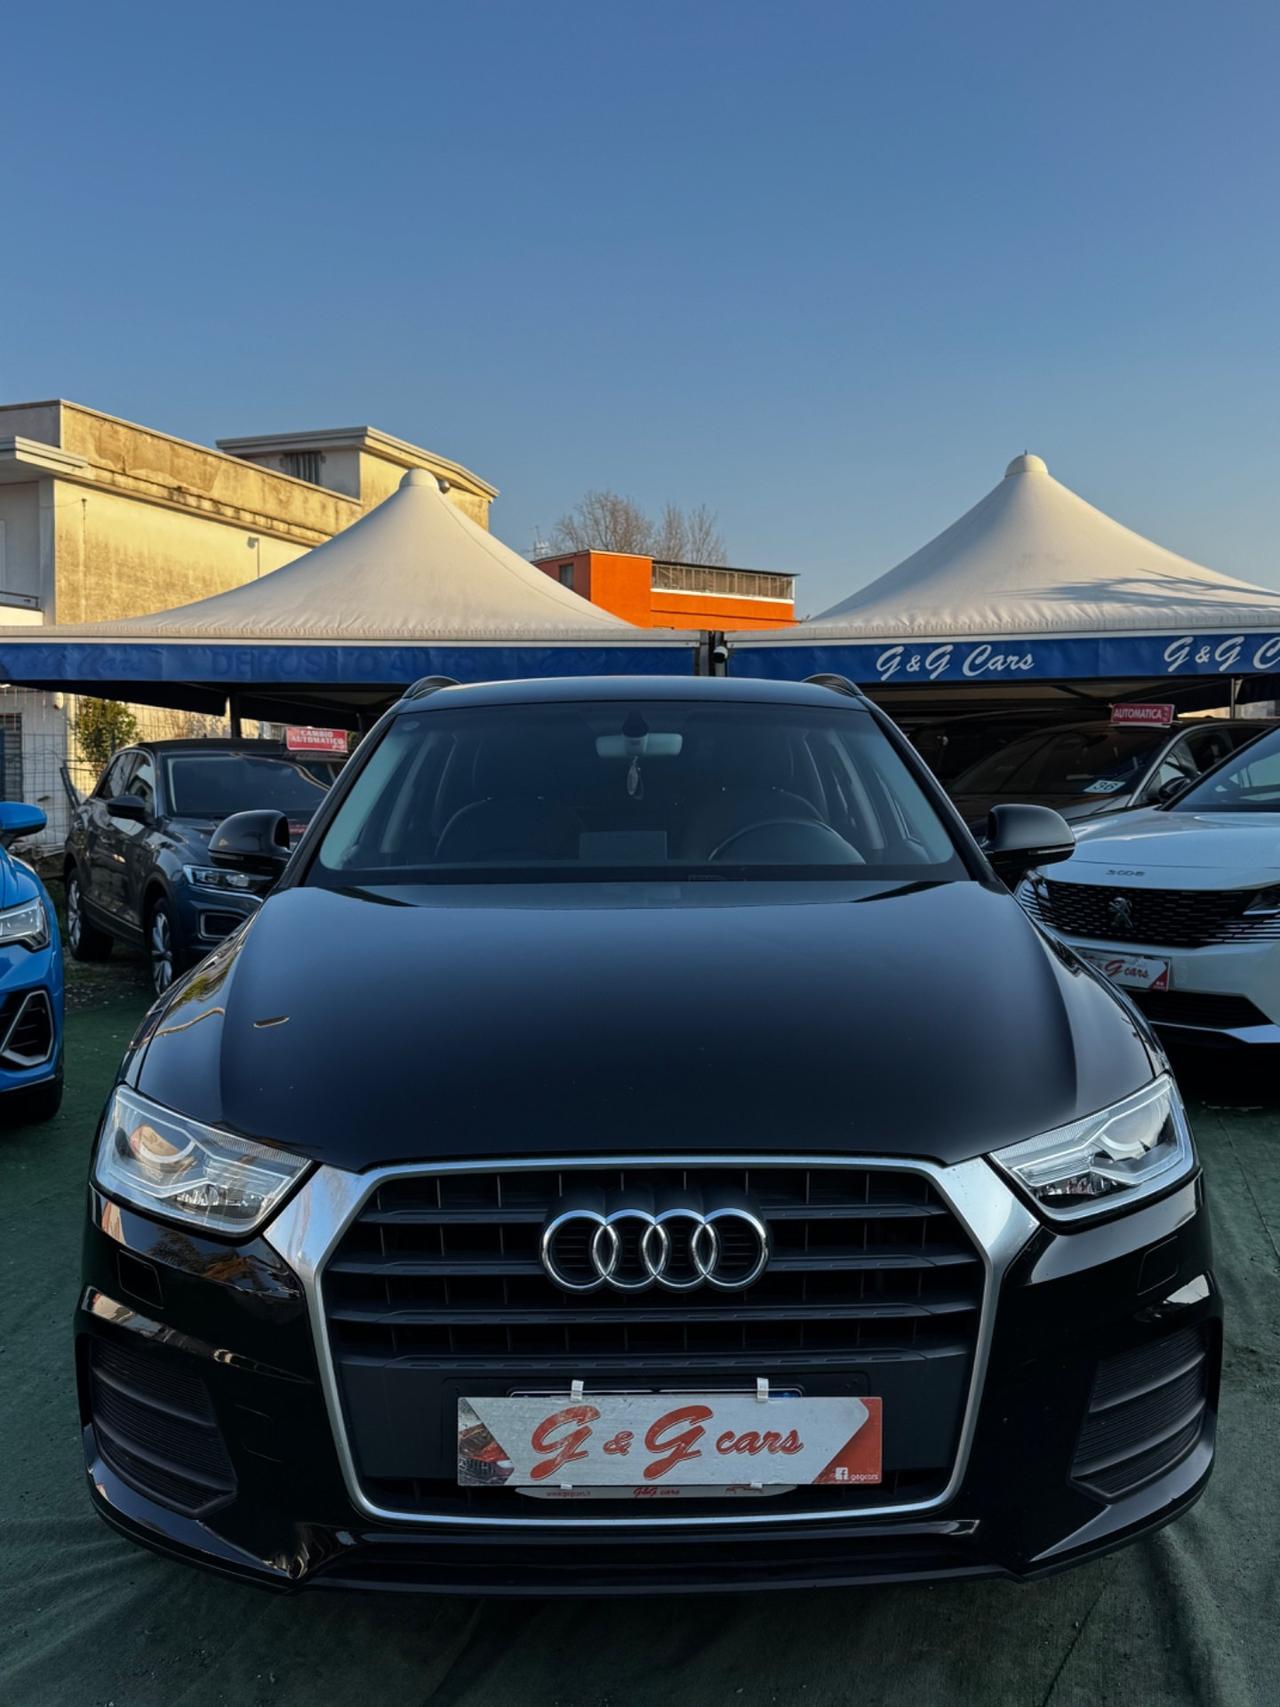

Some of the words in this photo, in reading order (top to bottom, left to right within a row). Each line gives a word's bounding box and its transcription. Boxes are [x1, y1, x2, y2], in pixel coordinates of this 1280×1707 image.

[962, 644, 1034, 677] Cars
[1112, 707, 1162, 719] AUTOMATICA
[300, 729, 334, 738] CAMBIO
[291, 735, 344, 745] AUTOMATICO
[715, 1429, 804, 1456] cars
